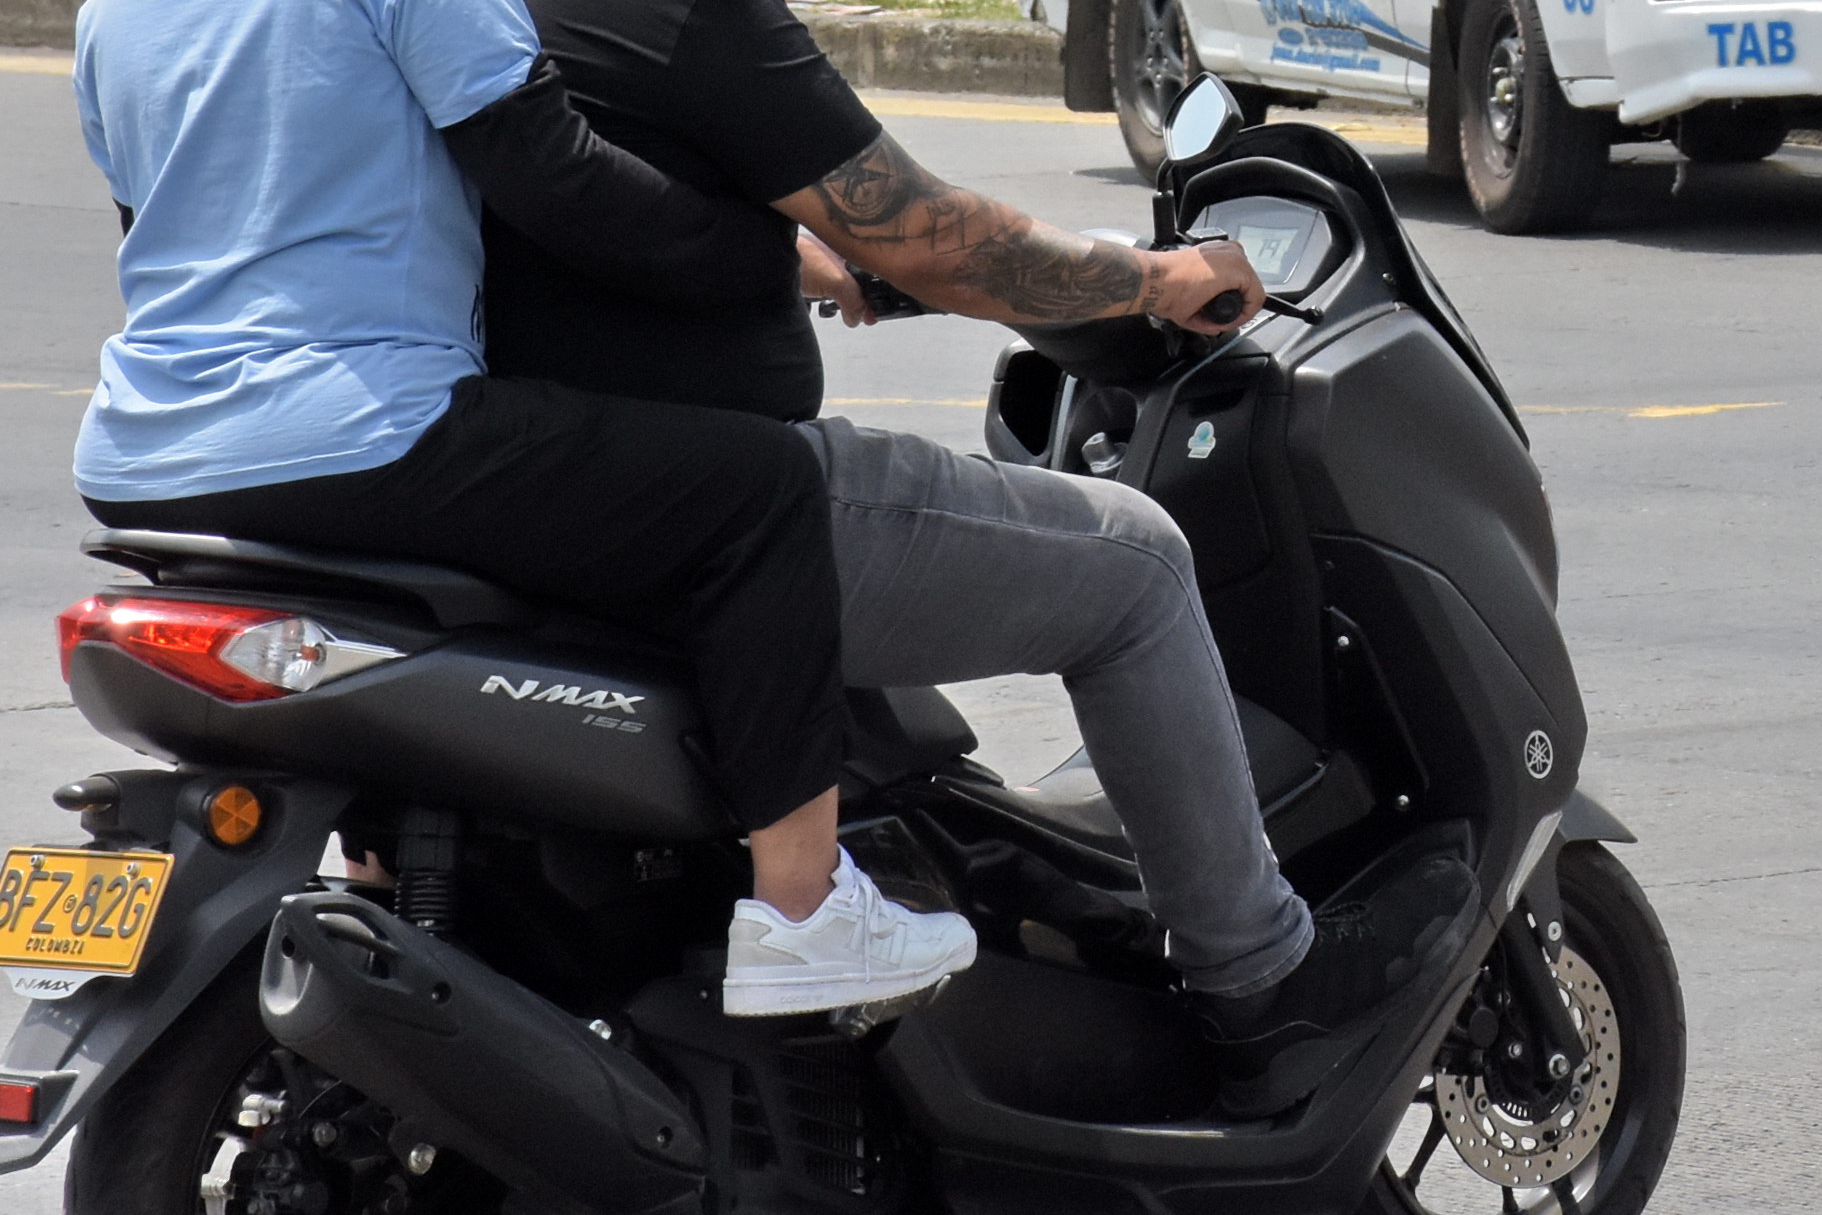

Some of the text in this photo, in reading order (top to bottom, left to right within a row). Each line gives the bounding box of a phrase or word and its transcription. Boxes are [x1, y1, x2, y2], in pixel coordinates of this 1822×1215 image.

[1708, 21, 1796, 67] TAB
[582, 714, 647, 733] 155
[25, 937, 86, 955] COLOMBIA
